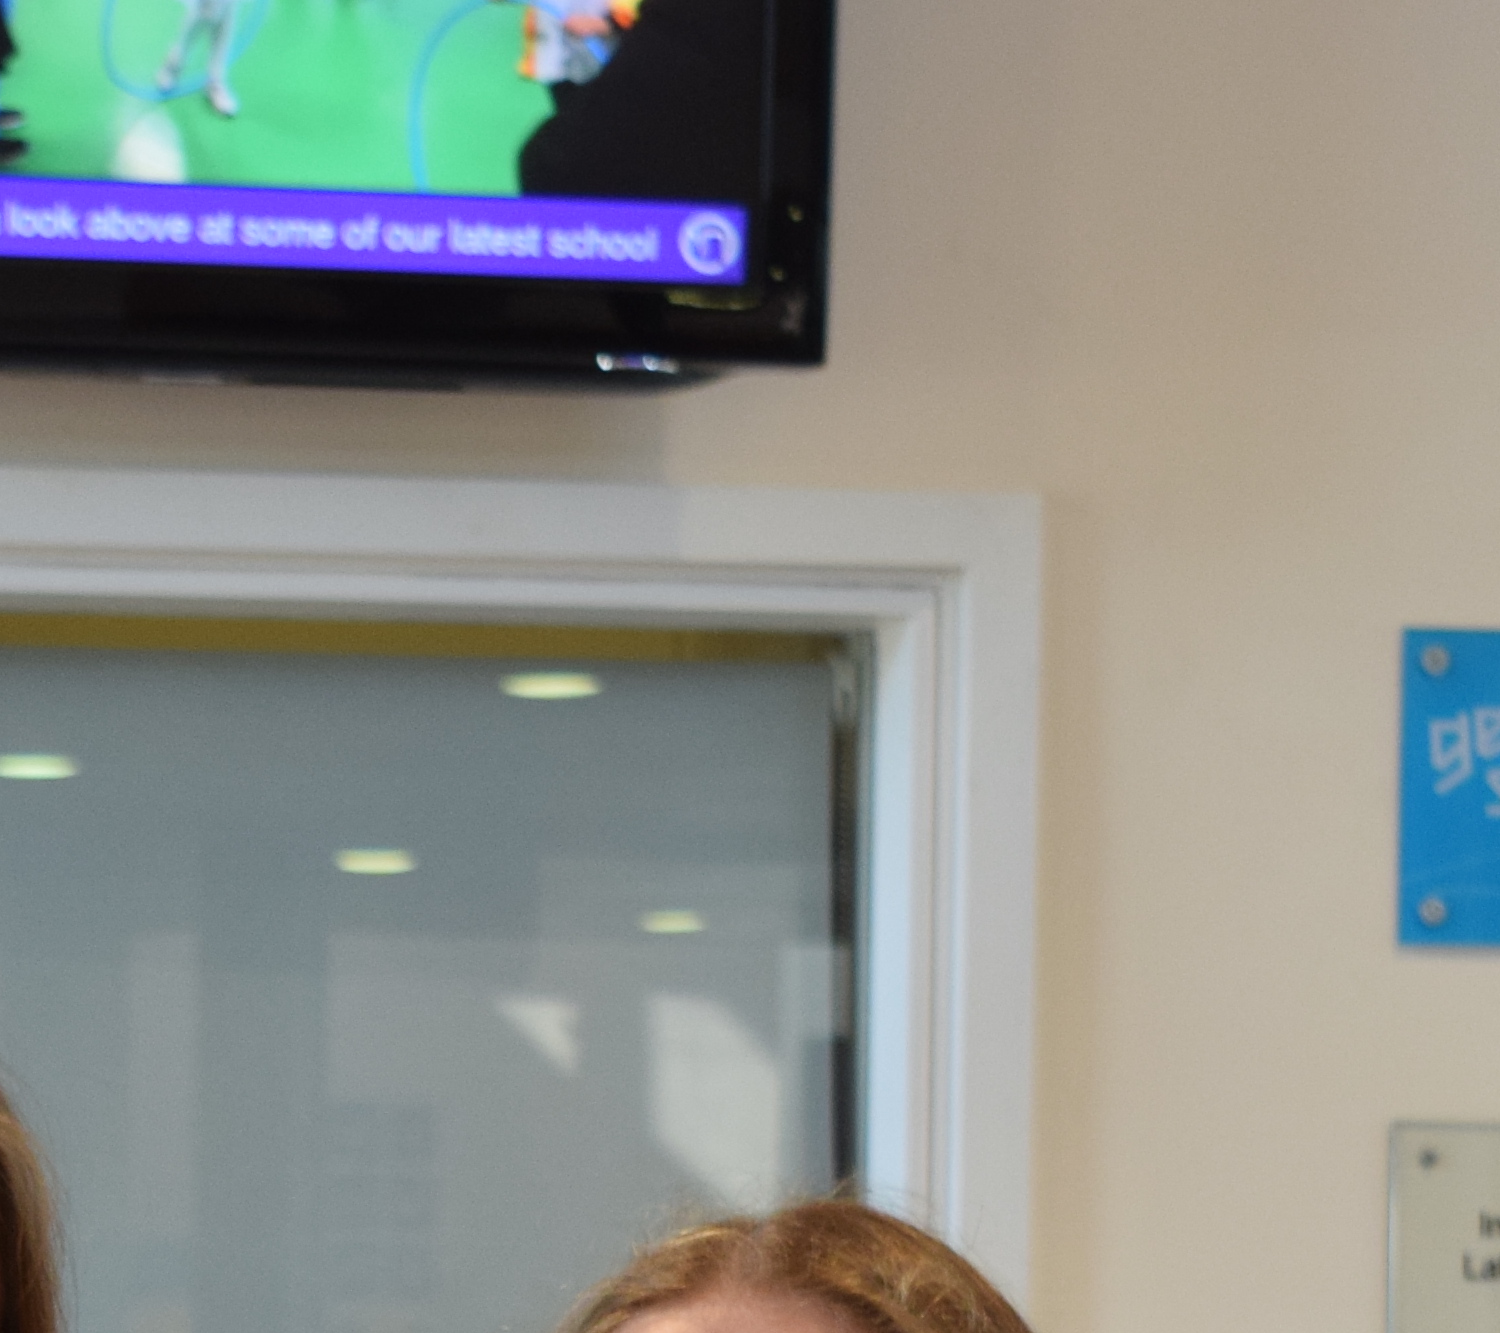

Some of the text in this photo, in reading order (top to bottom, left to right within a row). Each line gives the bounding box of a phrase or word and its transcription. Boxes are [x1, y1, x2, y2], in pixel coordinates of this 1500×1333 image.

[3, 198, 80, 240] look
[84, 203, 193, 244] above
[196, 210, 235, 247] at
[237, 216, 336, 251] some
[340, 213, 380, 252] of
[382, 222, 442, 254] our
[446, 217, 543, 258] latest
[546, 221, 661, 263] school
